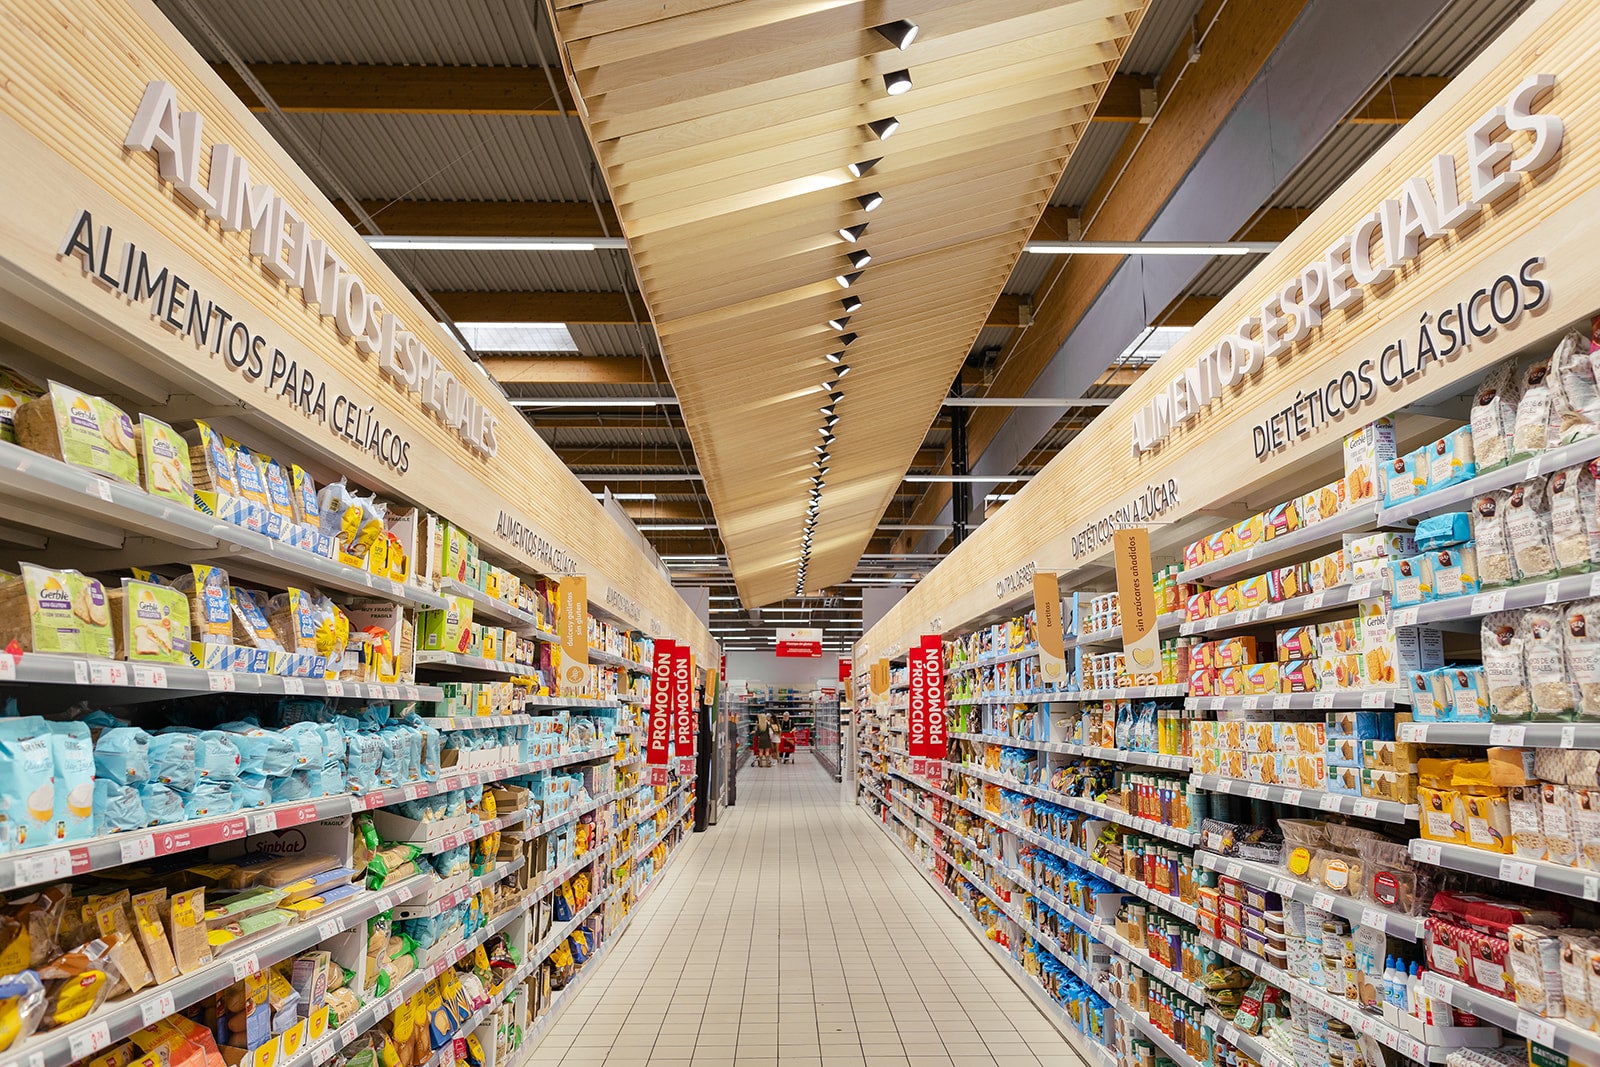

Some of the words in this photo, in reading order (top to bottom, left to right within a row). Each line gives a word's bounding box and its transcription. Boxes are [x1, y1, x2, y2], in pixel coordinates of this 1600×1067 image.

[124, 79, 385, 356] ALIMENTOS
[378, 312, 499, 458] ESPECIALES
[1131, 316, 1264, 457] ALIMENTOS
[1260, 73, 1564, 358] ESPECIALES
[60, 208, 267, 380] ALIMENTOS
[268, 346, 328, 423] PARA
[331, 394, 411, 474] CELÍACOS
[1251, 358, 1376, 459] DIETÉTICOS
[1379, 255, 1548, 388] CLÁSICOS
[494, 509, 538, 559] ALIMENTOS
[535, 536, 553, 566] PARA
[1071, 513, 1115, 559] DIETÉTICOS
[1115, 502, 1131, 527] SIN
[1132, 478, 1178, 524] AZÚCAR
[1128, 536, 1139, 577] añadidos
[40, 588, 69, 601] Gerblé
[1133, 578, 1143, 618] azúcares
[1136, 618, 1145, 632] sin
[1366, 616, 1386, 627] Gerblé
[652, 652, 671, 750] PROMOCIÓN
[674, 658, 690, 744] PROMOCIÓN
[911, 659, 926, 744] PROMOCIÓN
[924, 648, 943, 745] PROMOCIÓN
[255, 840, 301, 853] Sinblat
